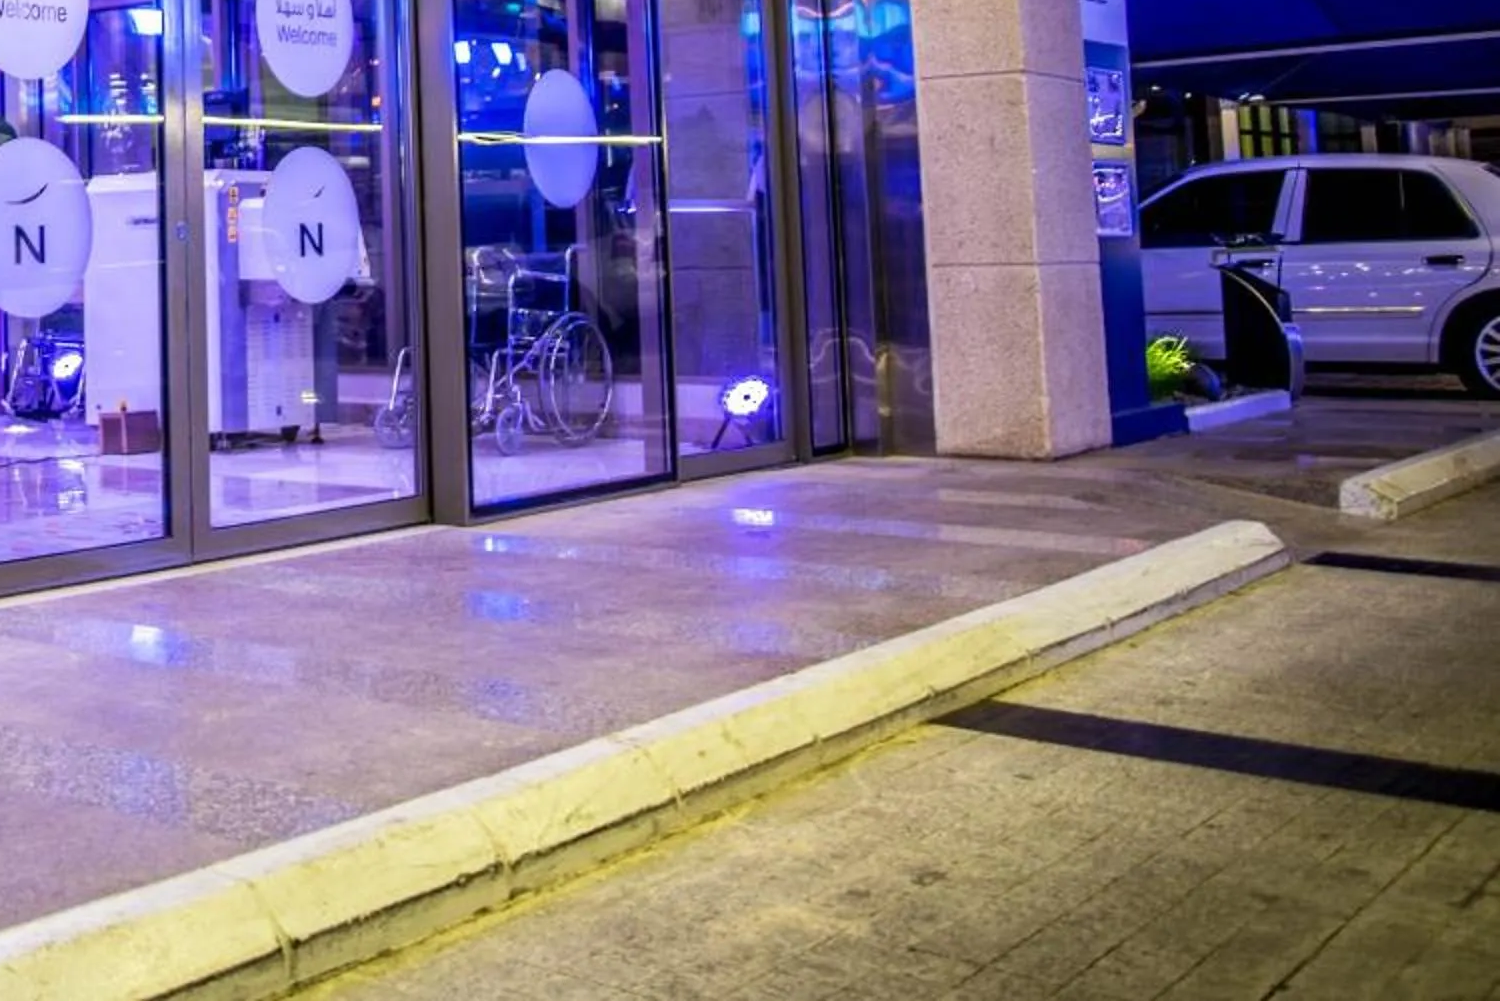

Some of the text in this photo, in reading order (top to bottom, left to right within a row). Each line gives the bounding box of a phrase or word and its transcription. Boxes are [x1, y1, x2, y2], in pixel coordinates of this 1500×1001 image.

[276, 24, 337, 47] Welcome
[14, 225, 45, 264] N
[299, 222, 324, 257] N
